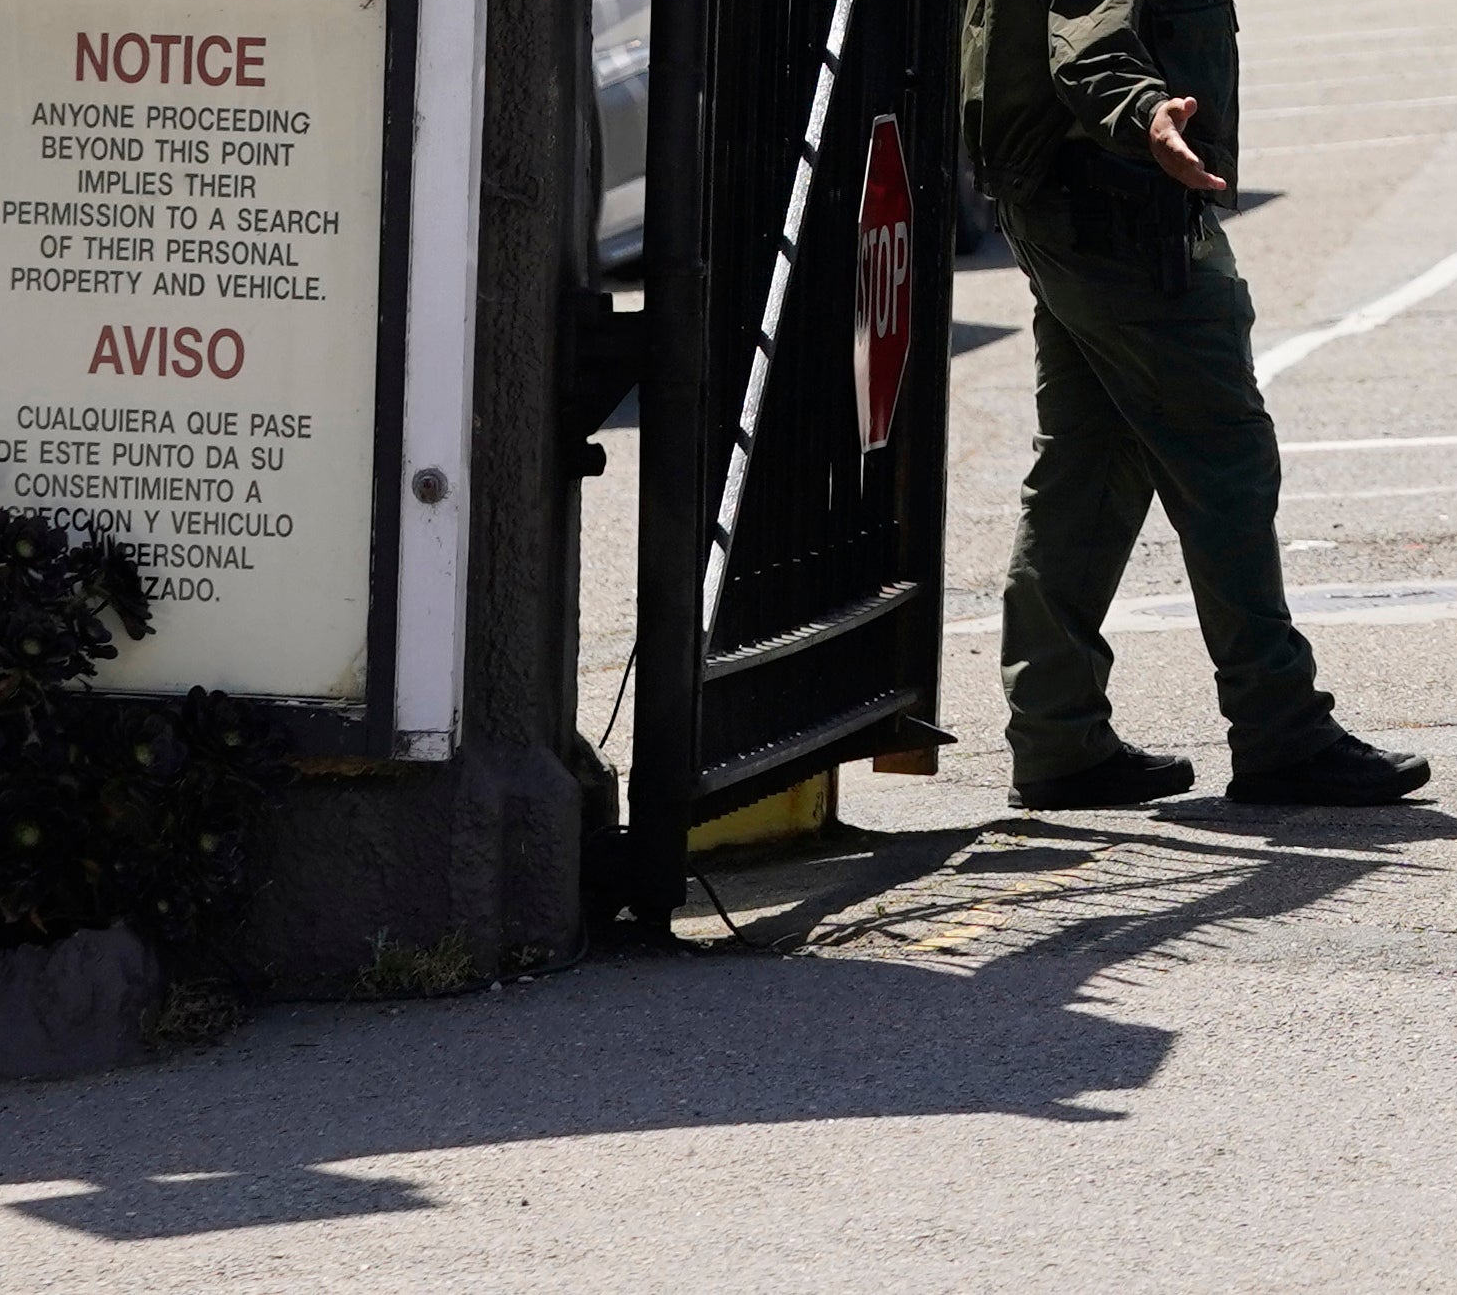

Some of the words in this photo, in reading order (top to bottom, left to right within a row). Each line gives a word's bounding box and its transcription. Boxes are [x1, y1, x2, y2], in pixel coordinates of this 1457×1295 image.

[76, 32, 266, 87] NOTICE
[32, 103, 134, 128] ANYONE
[147, 106, 310, 134] PROCEEDING
[42, 136, 143, 161] BEYOND
[155, 139, 209, 164] THIS
[222, 141, 294, 166] POINT
[79, 170, 172, 196] IMPLIES
[184, 173, 256, 198] THEIR
[3, 201, 154, 228] PERMISSION
[166, 206, 197, 230] TO
[209, 208, 225, 230] A
[237, 208, 338, 234] SEARCH
[41, 235, 72, 258] OF
[83, 237, 153, 261] THEIR
[167, 239, 299, 266] PERSONAL
[11, 267, 142, 294] PROPERTY
[153, 272, 205, 296] AND
[217, 274, 326, 300] VEHICLE.
[857, 221, 908, 339] STOP
[88, 325, 245, 379] AVISO
[18, 406, 175, 433] CUALQUIERA
[187, 411, 238, 436] QUE
[250, 414, 311, 438] PASE
[40, 441, 100, 465] ESTE
[113, 443, 194, 468] PUNTO
[207, 446, 239, 469] DA
[252, 447, 283, 471] SU
[15, 473, 234, 502] CONSENTIMIENTO
[245, 480, 262, 503] A
[144, 510, 160, 533] Y
[171, 511, 293, 537] VEHICULO
